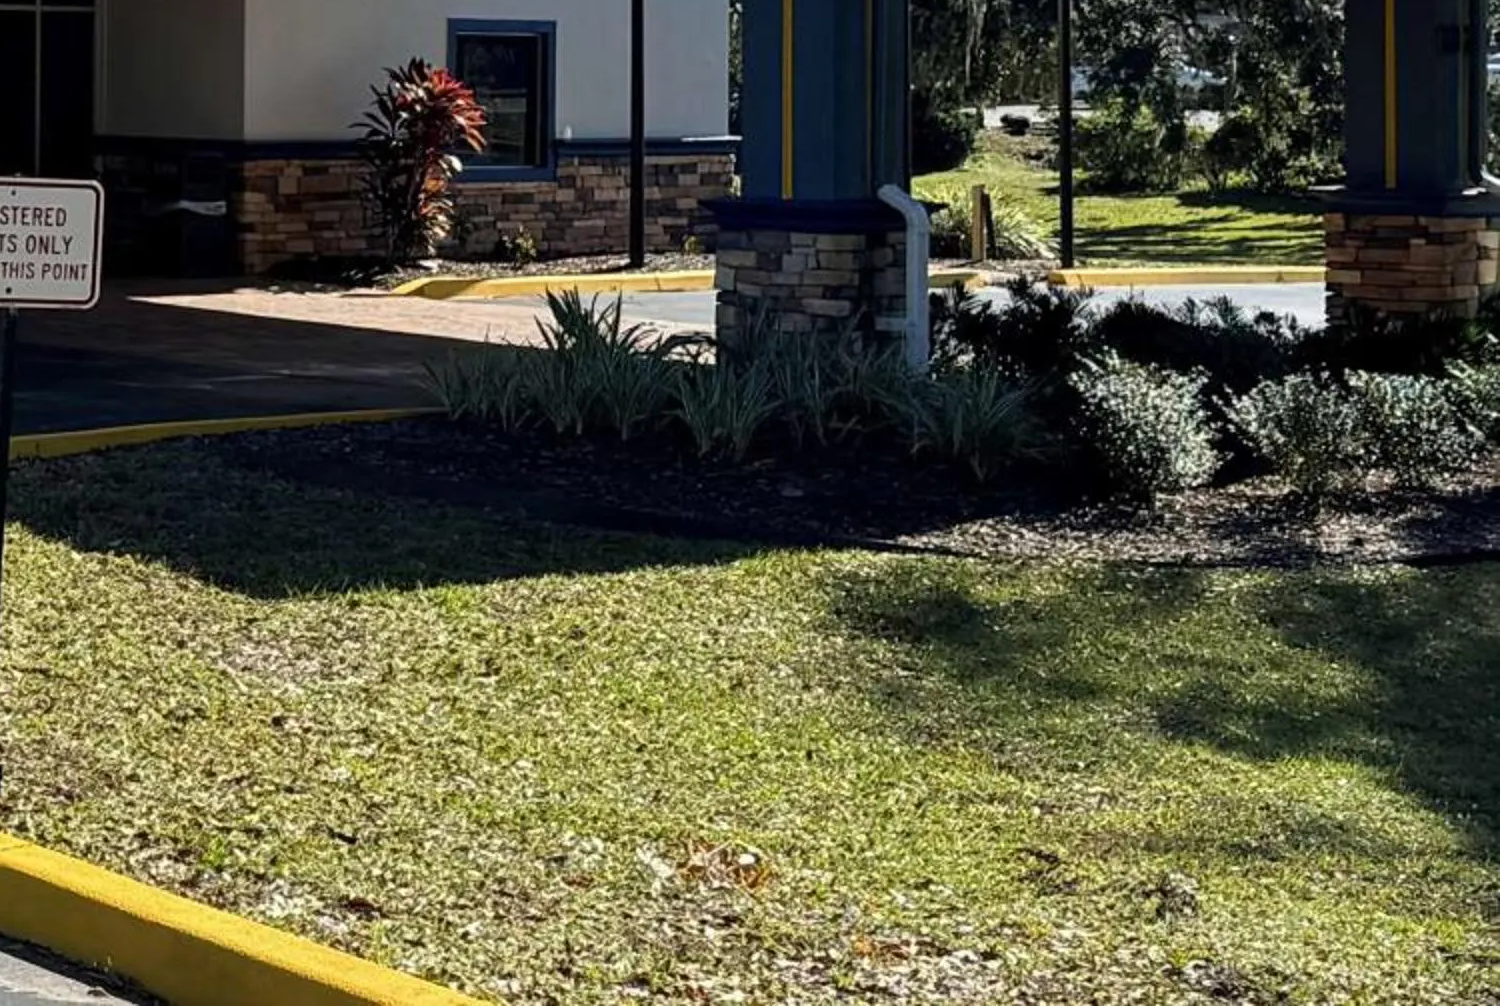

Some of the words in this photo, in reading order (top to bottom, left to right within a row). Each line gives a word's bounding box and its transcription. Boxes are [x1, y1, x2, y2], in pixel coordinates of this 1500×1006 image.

[25, 235, 73, 255] ONLY
[1, 262, 35, 279] THIS
[41, 263, 88, 281] POINT
